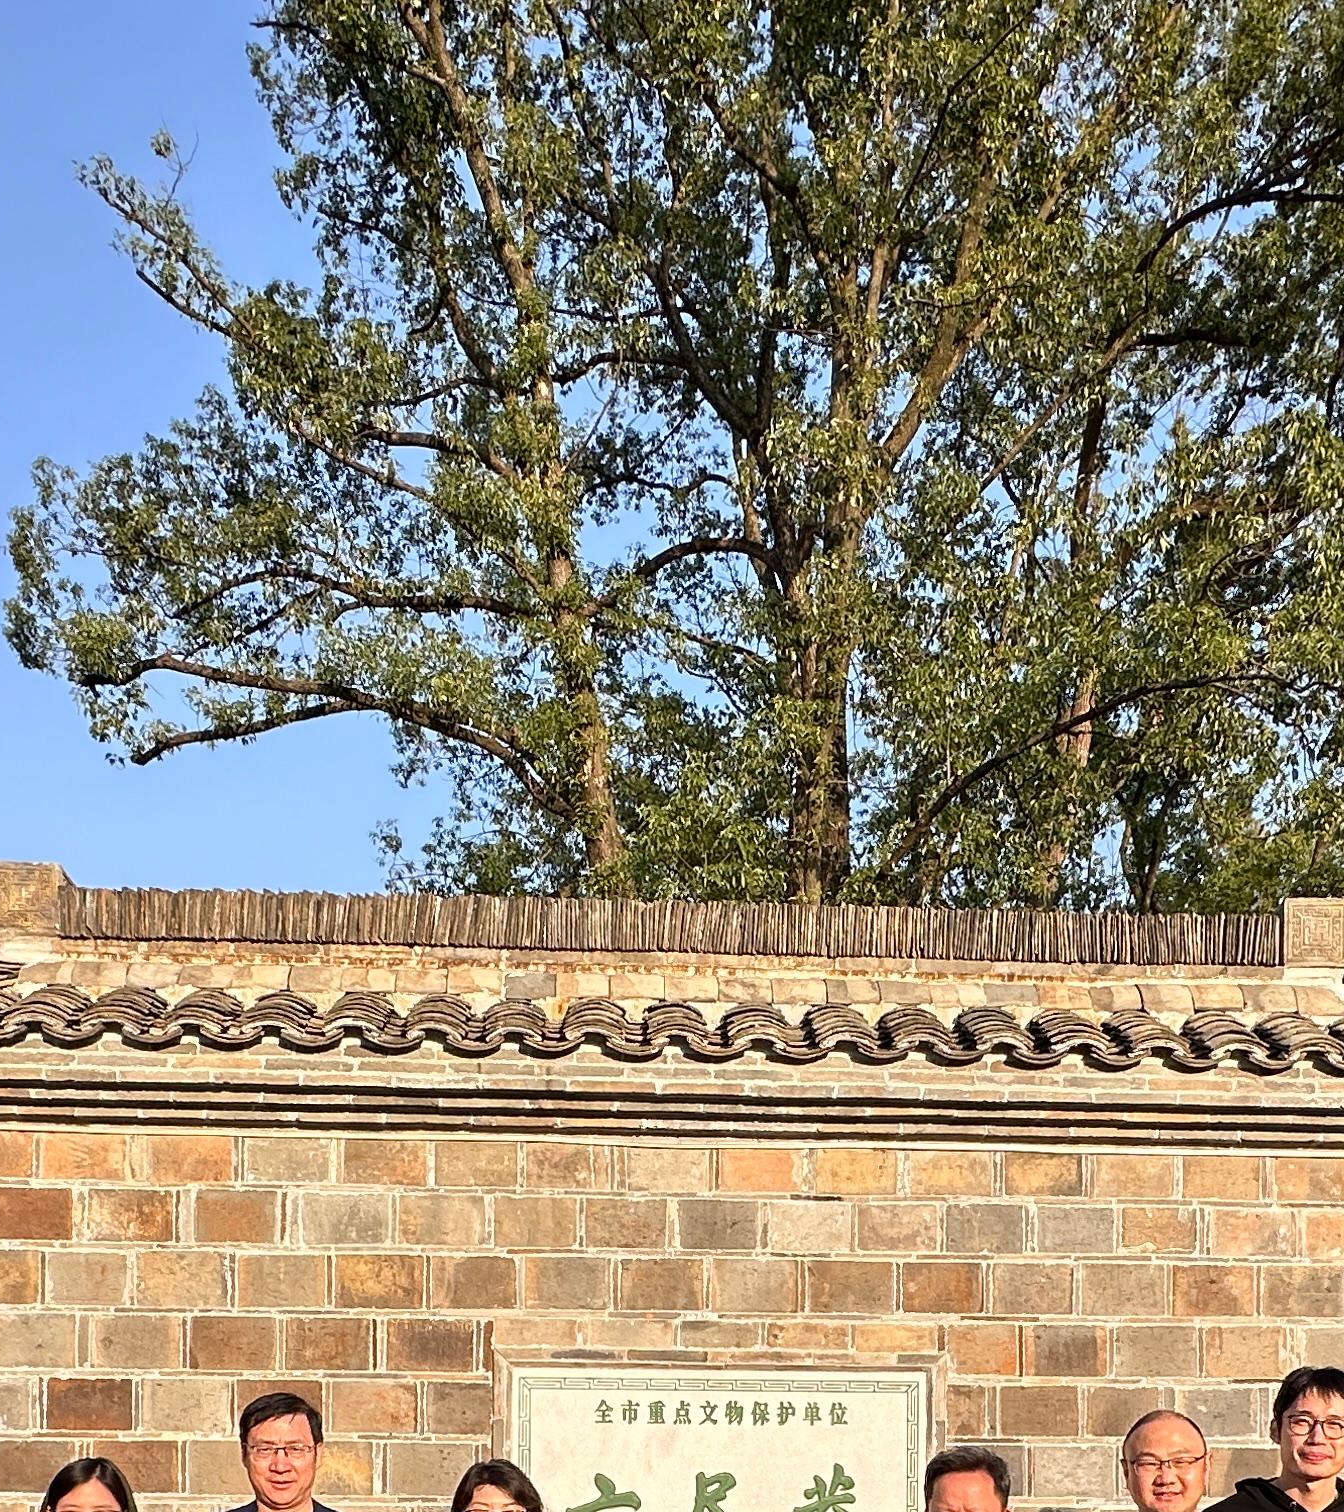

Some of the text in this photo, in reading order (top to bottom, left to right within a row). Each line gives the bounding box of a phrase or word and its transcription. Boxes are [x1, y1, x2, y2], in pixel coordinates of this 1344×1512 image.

[595, 1399, 848, 1426] 全市重点文物保护单位
